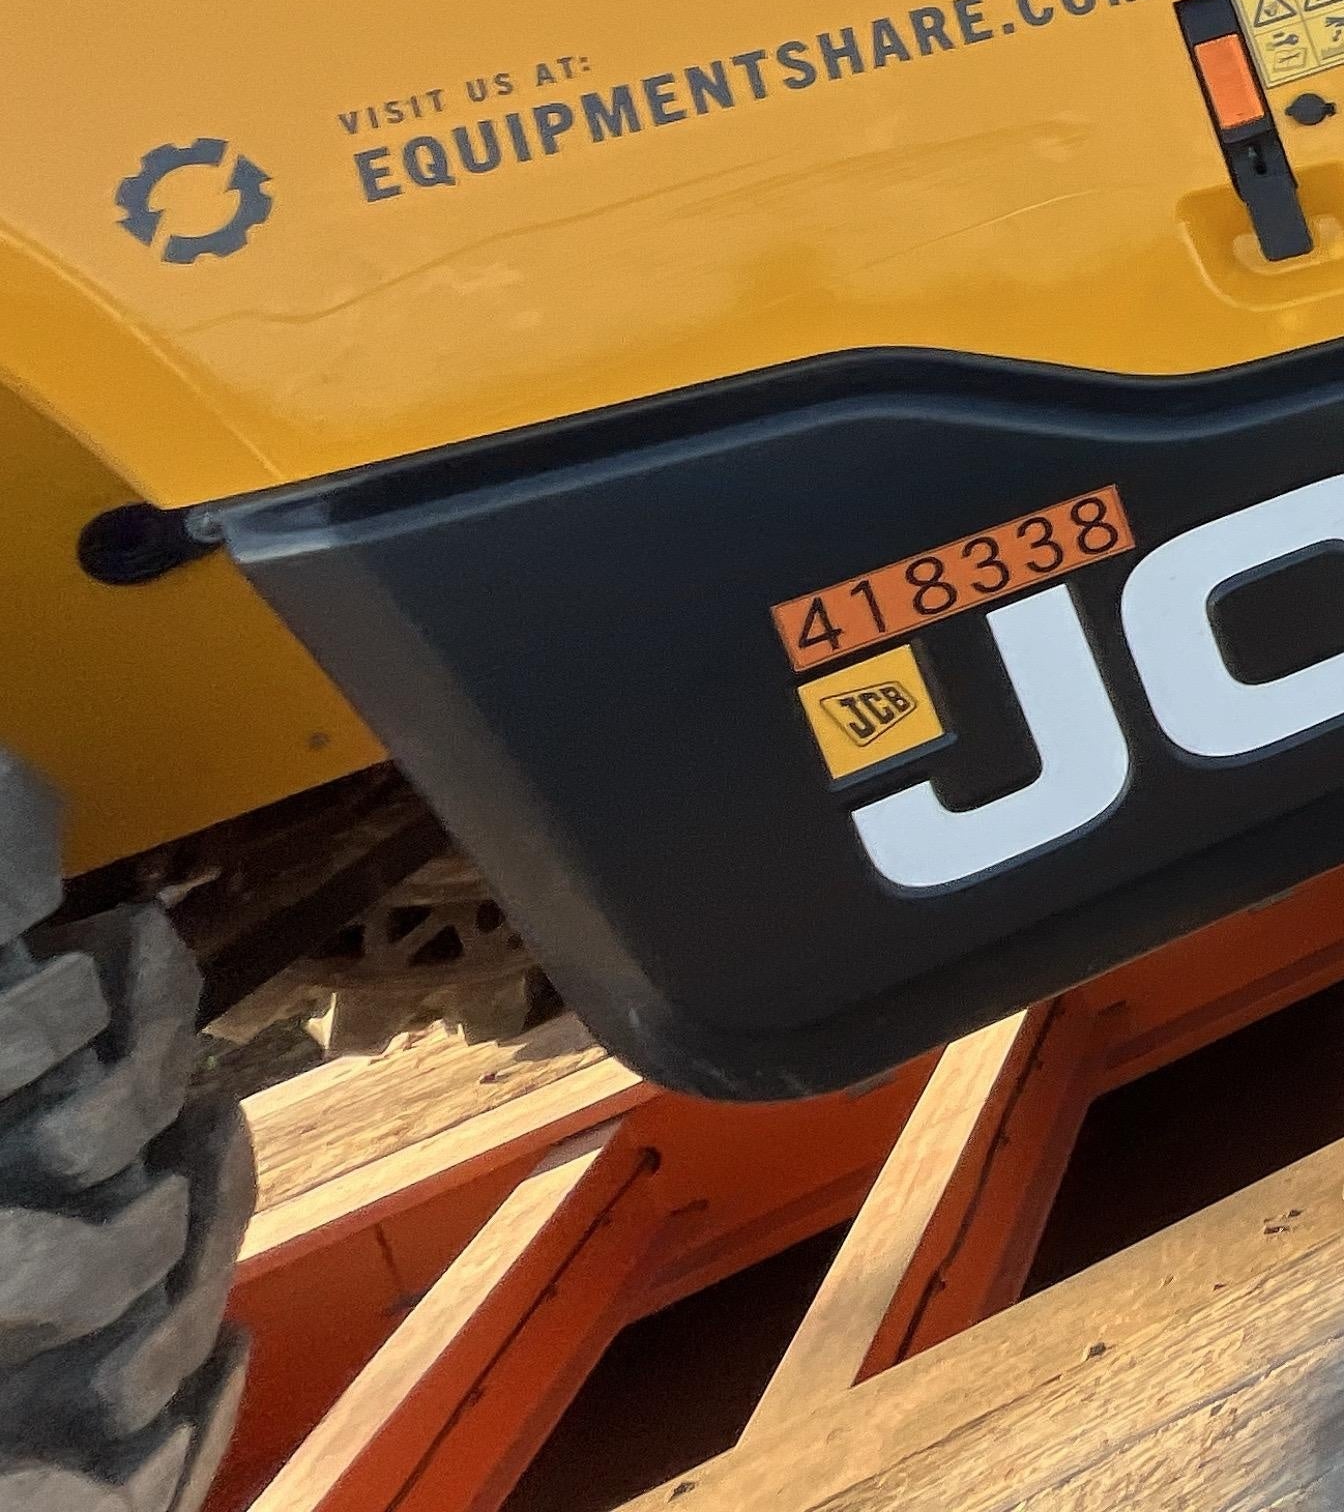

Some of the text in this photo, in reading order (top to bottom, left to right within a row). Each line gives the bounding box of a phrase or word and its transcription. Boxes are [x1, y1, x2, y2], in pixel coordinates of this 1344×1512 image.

[337, 53, 593, 136] VISIT US AT:
[797, 495, 1120, 652] 418338
[840, 686, 911, 739] JCB
